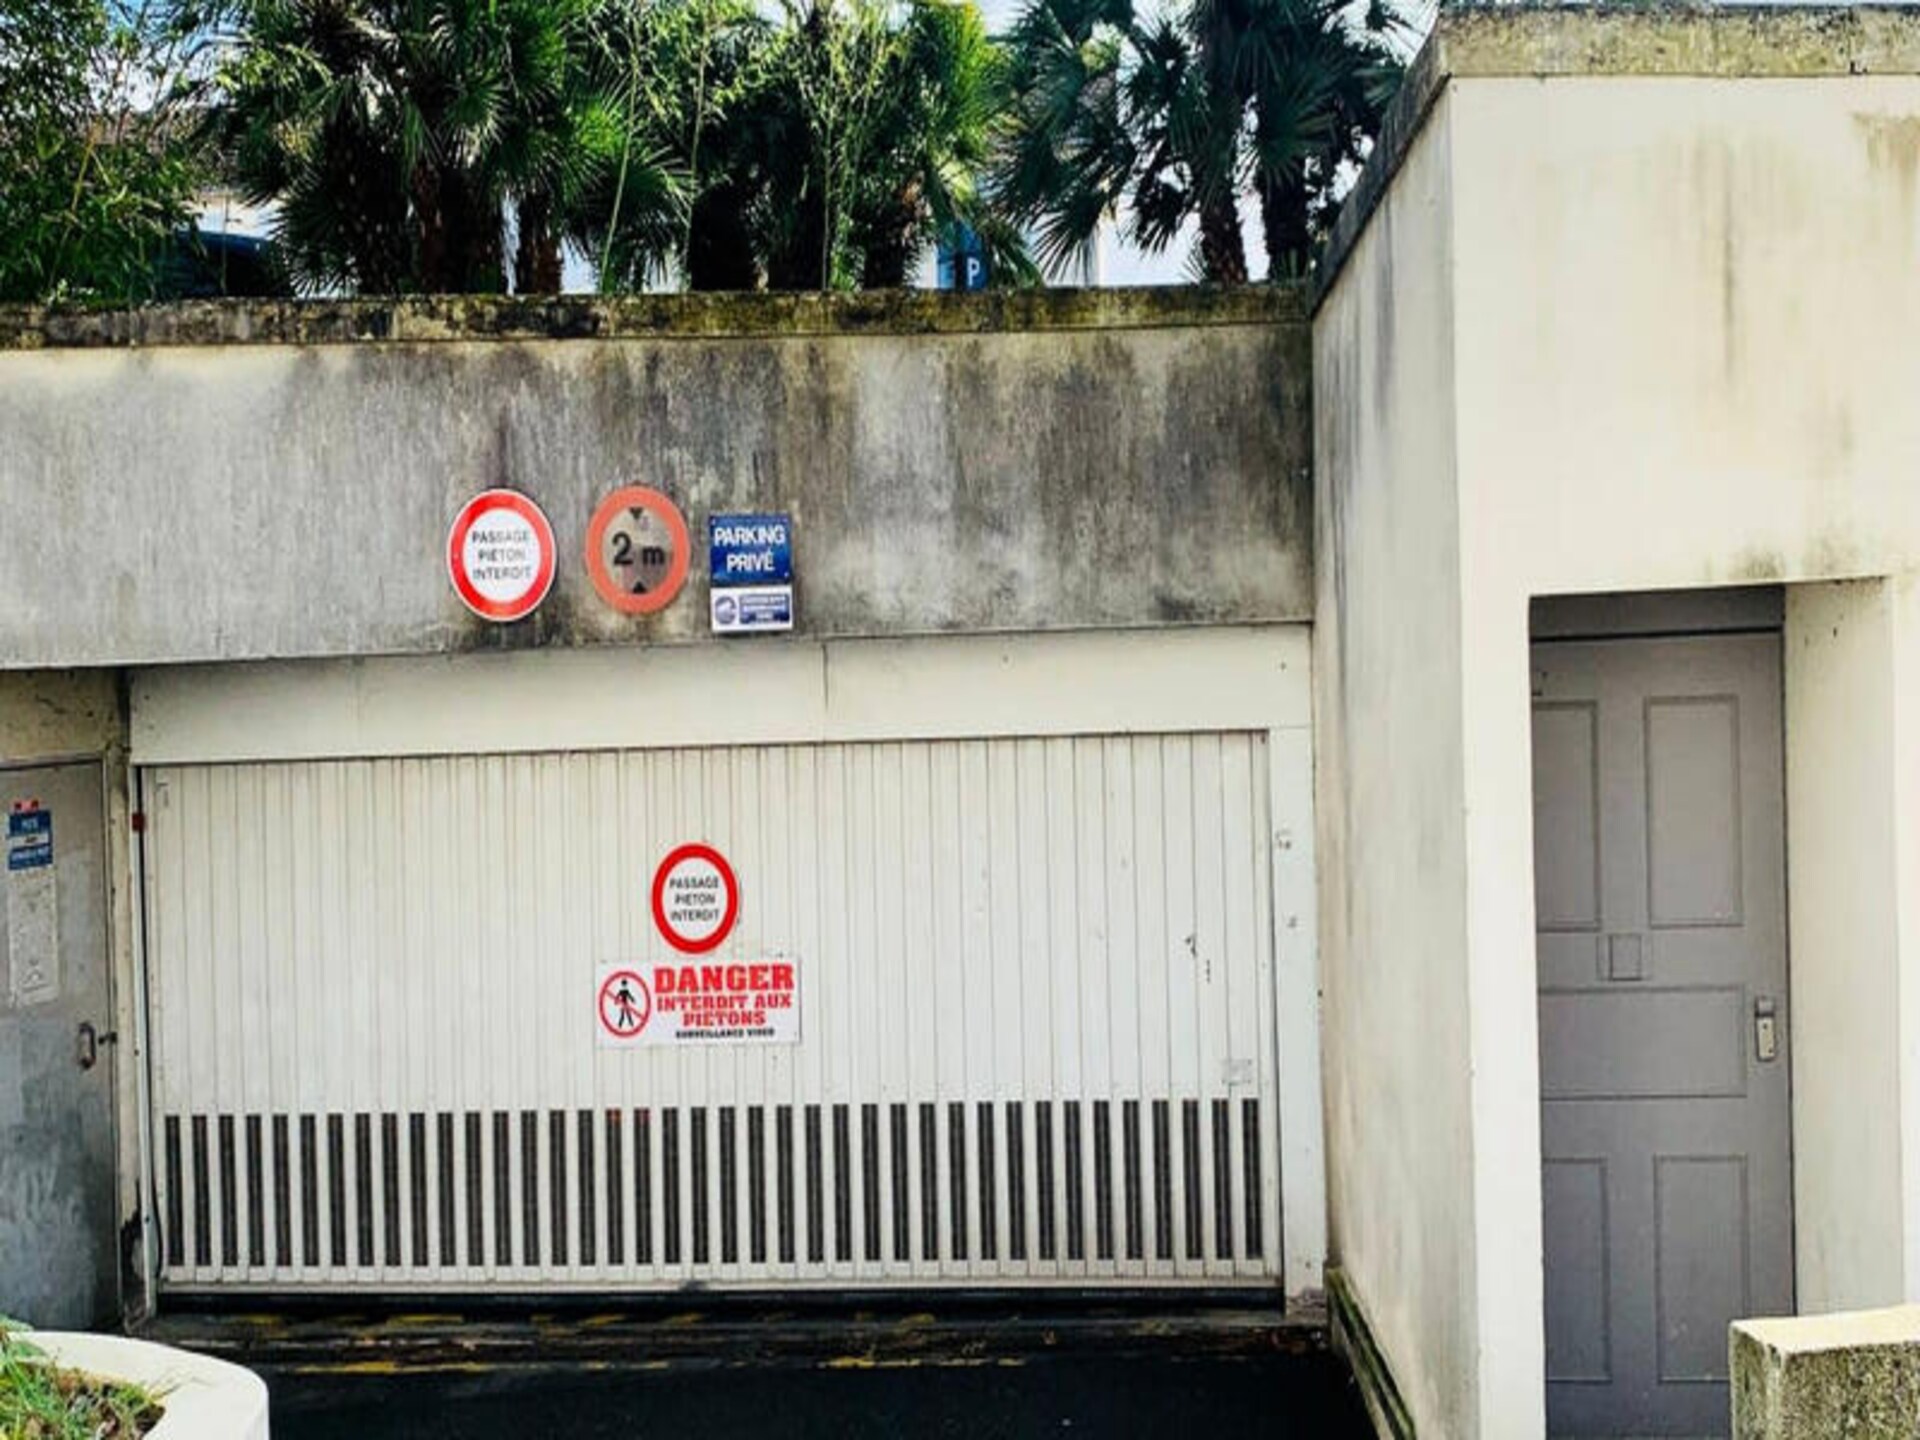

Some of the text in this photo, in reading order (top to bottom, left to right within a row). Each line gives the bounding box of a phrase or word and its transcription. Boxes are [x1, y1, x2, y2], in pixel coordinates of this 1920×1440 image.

[967, 257, 980, 287] P
[472, 529, 529, 544] PASSAGE
[714, 524, 786, 547] PARKING
[612, 532, 665, 566] 2 m
[726, 547, 776, 574] PRIVÉ
[472, 566, 531, 580] INTERDIT
[669, 876, 719, 889] PASSAGE
[671, 908, 720, 922] INTERDIT
[654, 963, 794, 993] DANGER
[657, 992, 792, 1012] INTERDIT AUX
[683, 1011, 767, 1027] PIETONS
